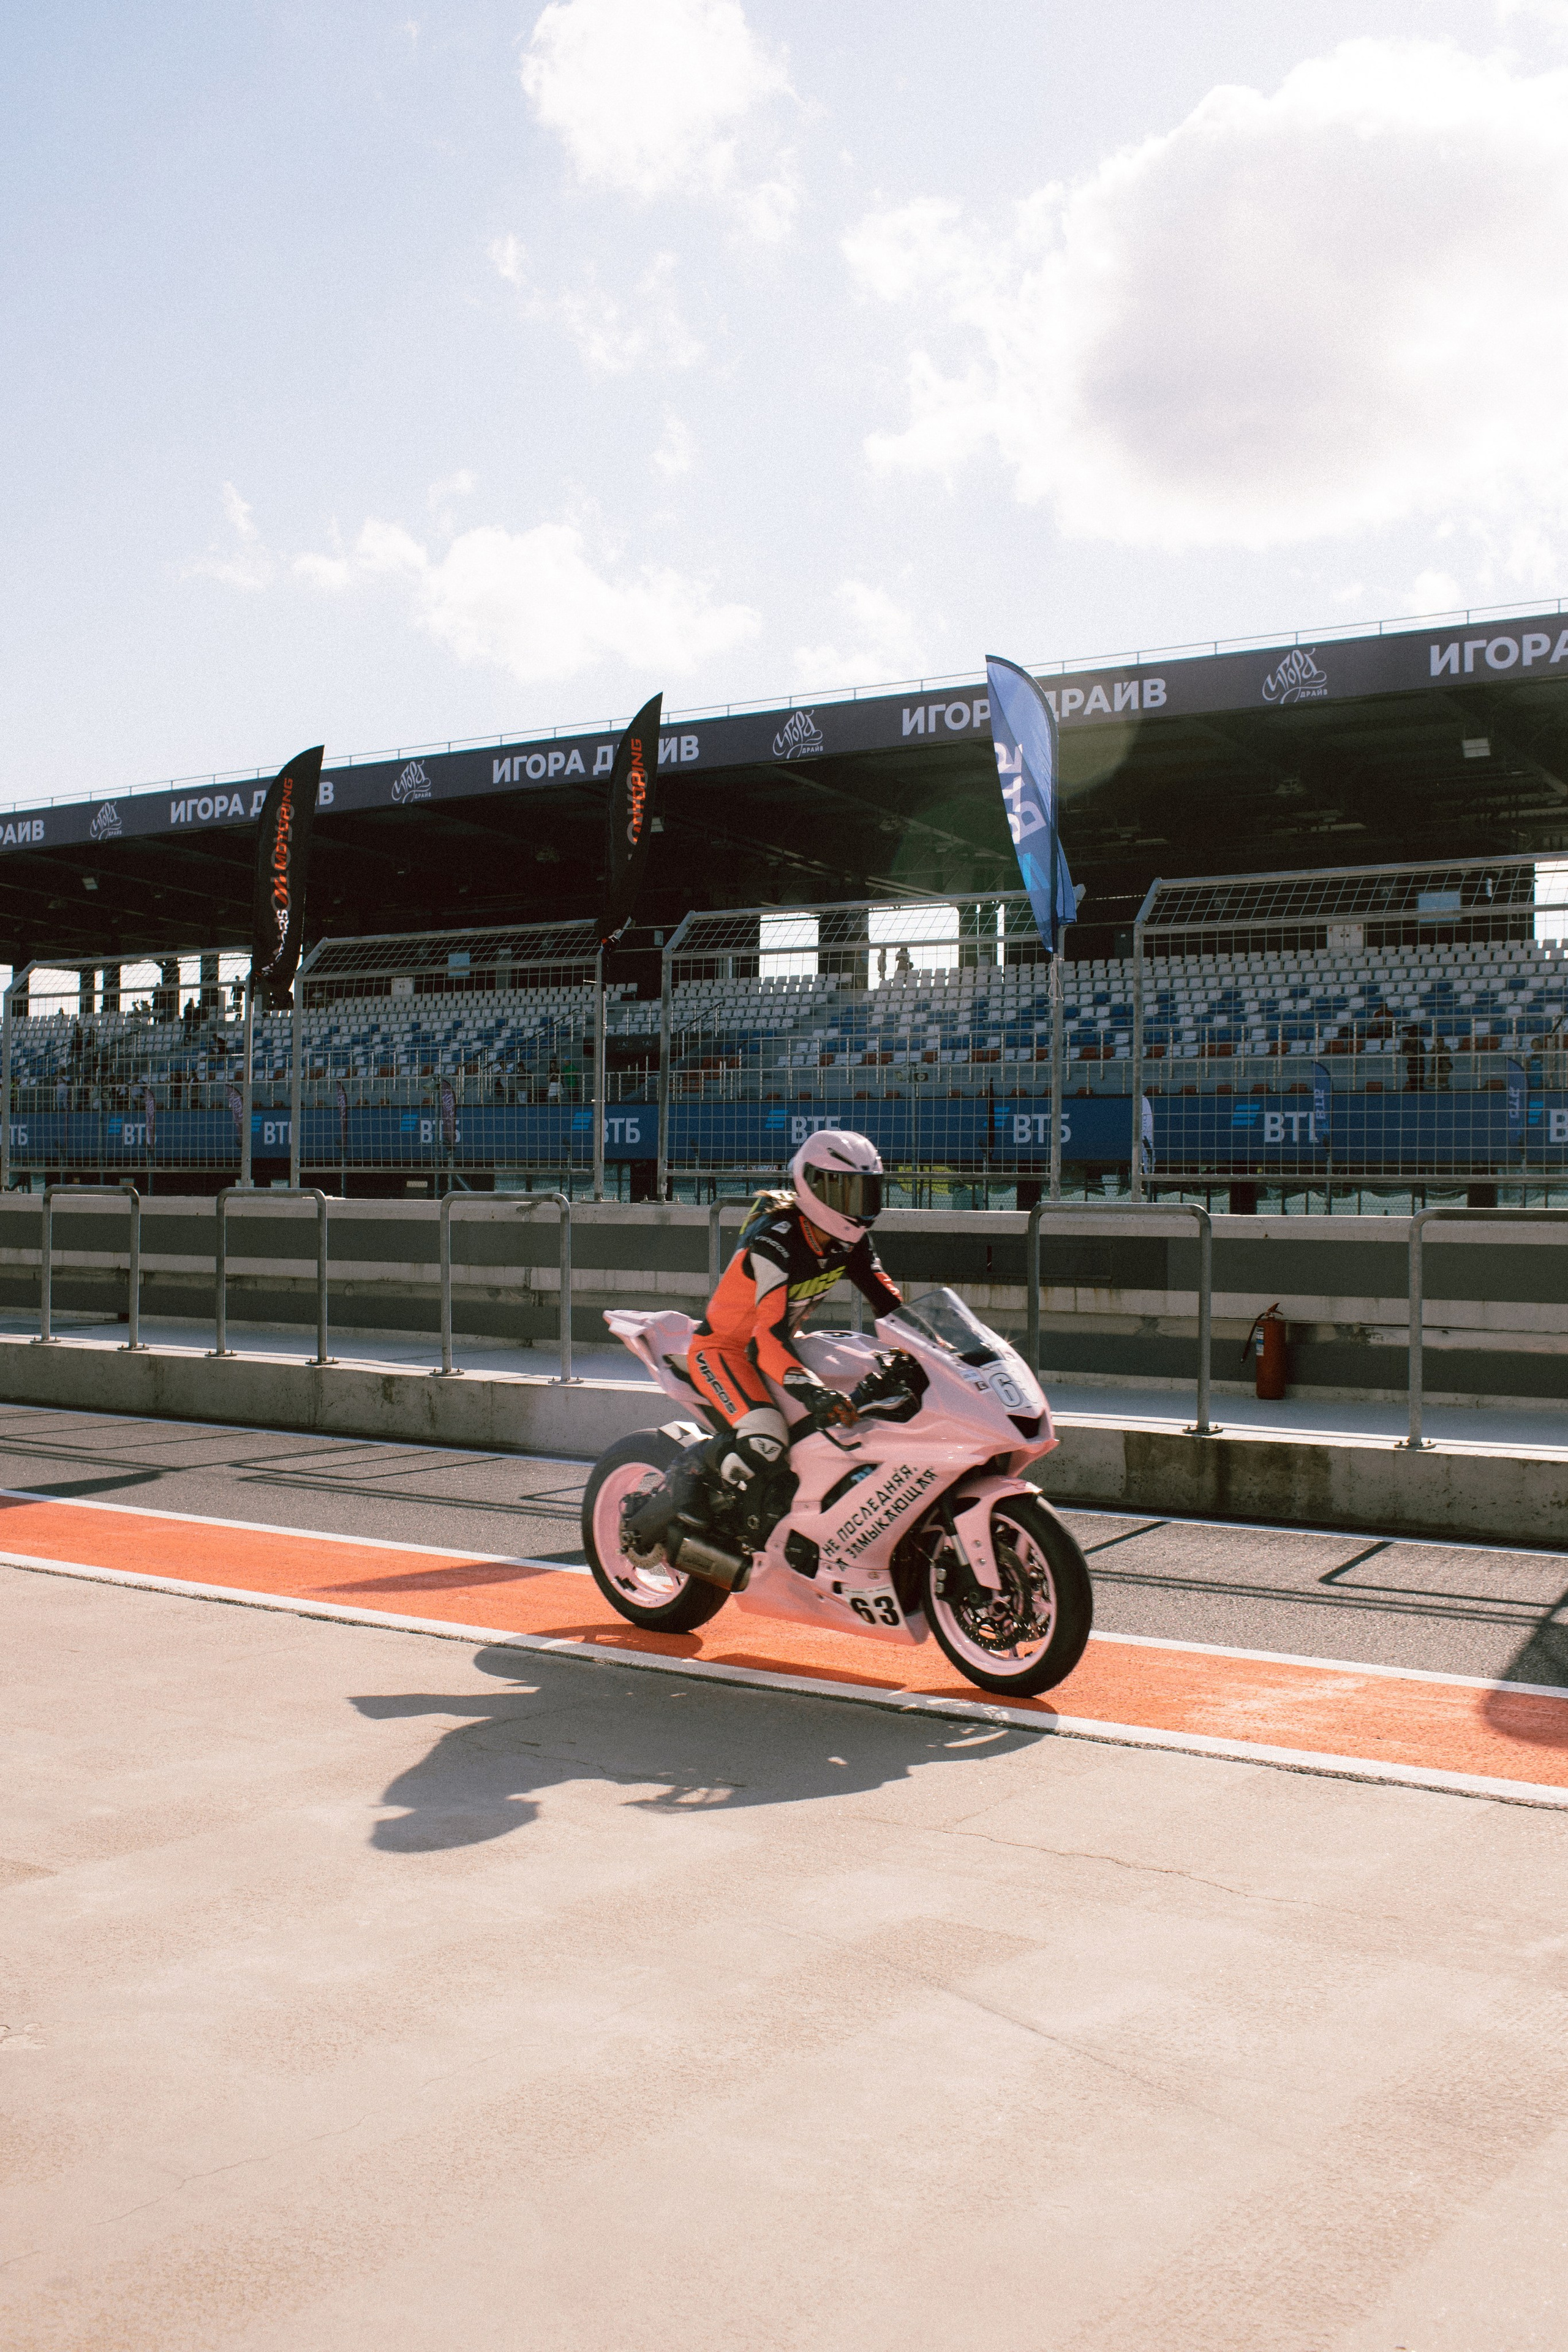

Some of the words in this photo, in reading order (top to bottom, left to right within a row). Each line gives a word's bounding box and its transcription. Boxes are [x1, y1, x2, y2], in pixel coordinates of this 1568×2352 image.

[1300, 688, 1328, 698] ДРАЙВ
[902, 701, 991, 736] ИГОР
[492, 749, 586, 784] ИГОРА
[593, 735, 699, 775] ДЙВ
[171, 793, 245, 824] ИГОРА
[0, 1124, 28, 1145] ТБ
[264, 1121, 292, 1145] ВТ
[836, 1558, 851, 1572] А
[845, 1468, 938, 1559] ЗАМЫКАЮЩАЯ
[822, 1539, 840, 1558] НЕ
[850, 1596, 900, 1626] 63
